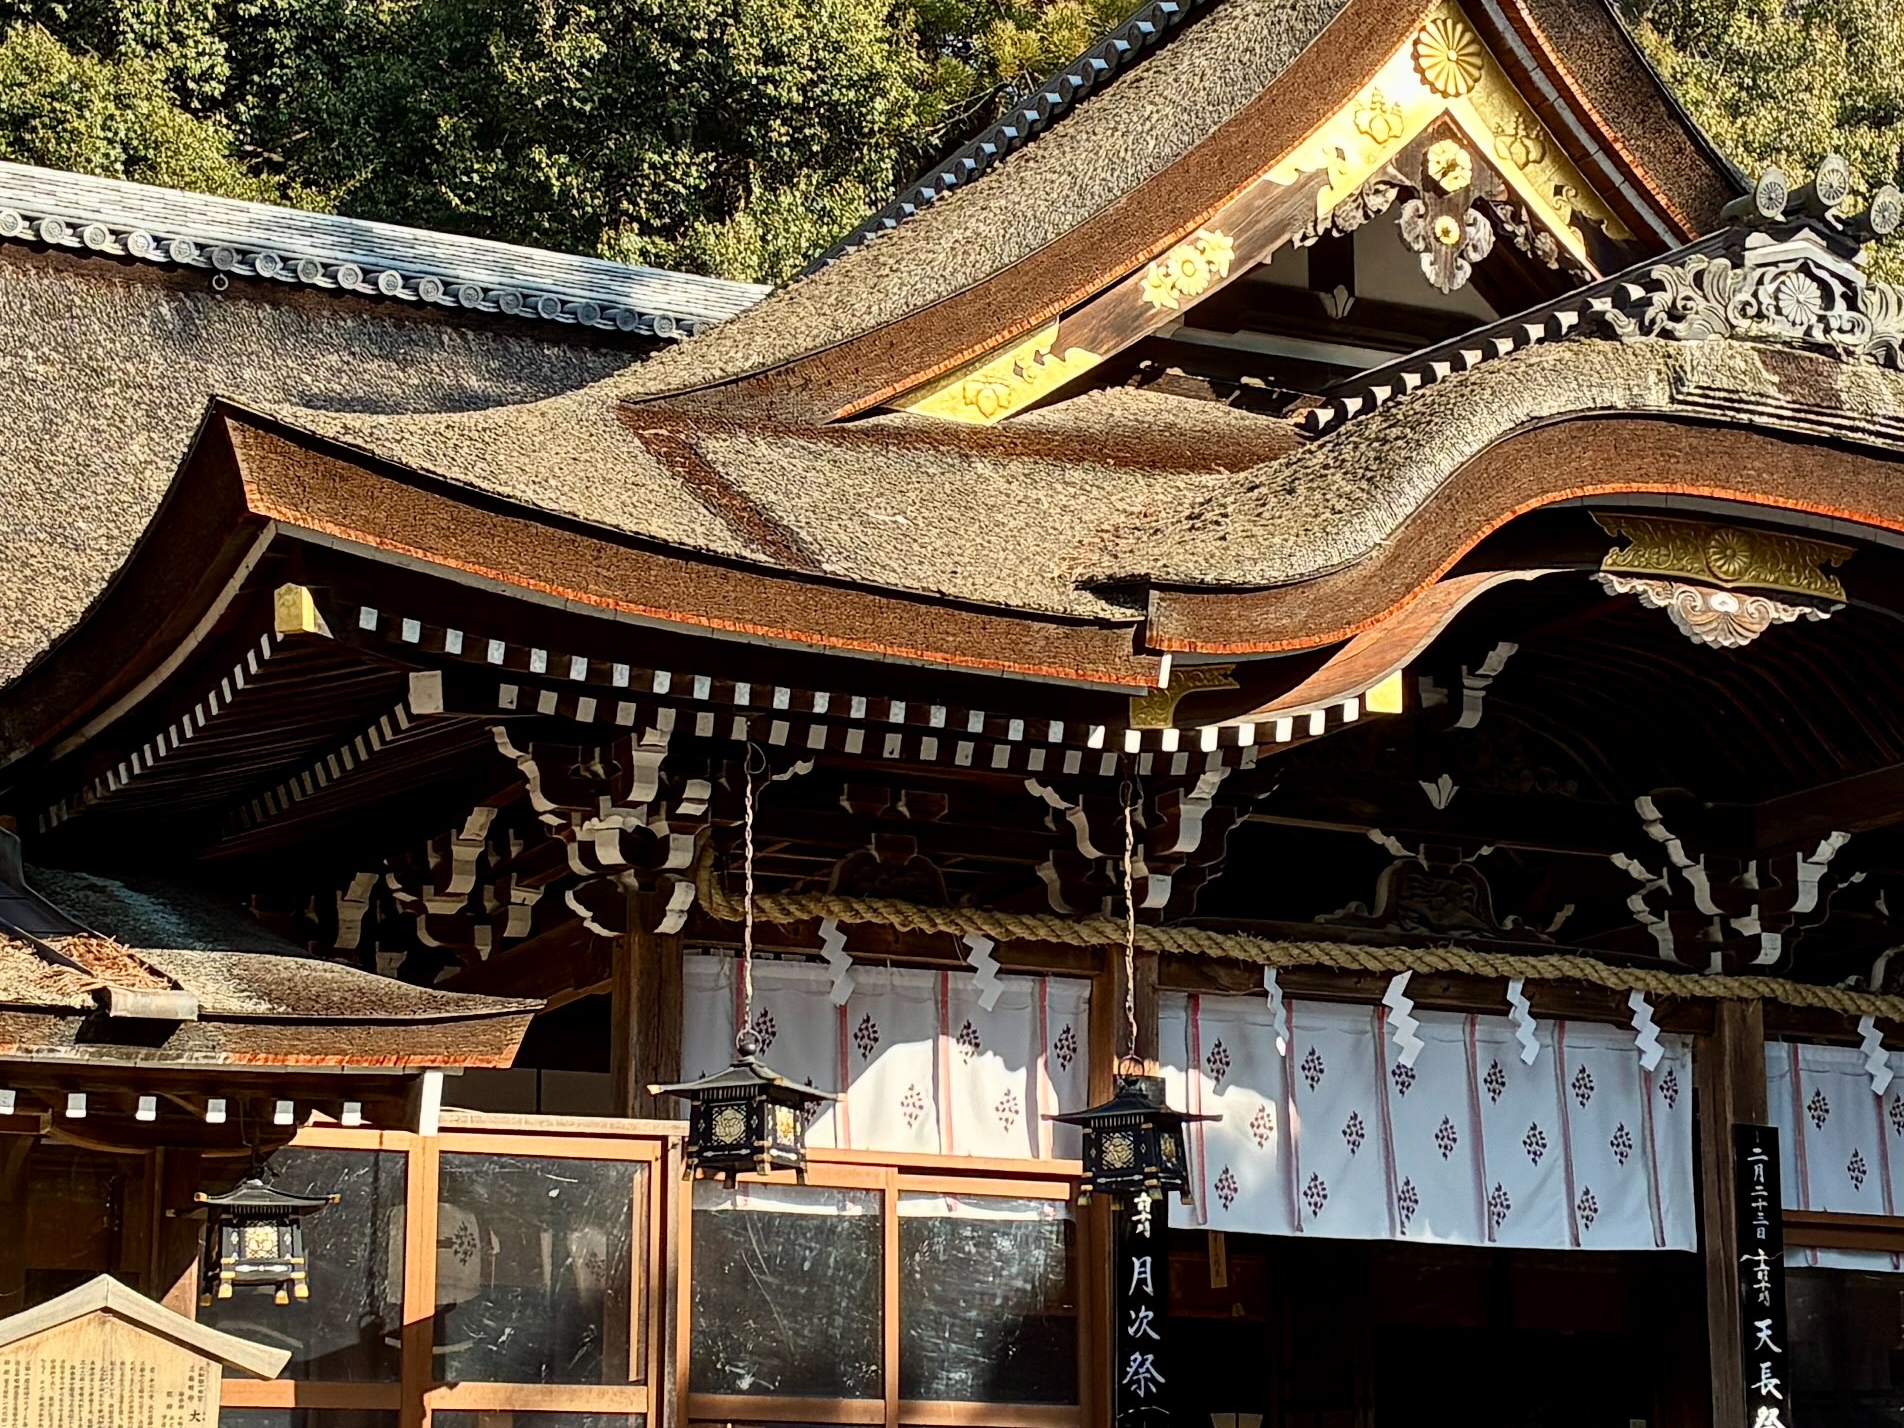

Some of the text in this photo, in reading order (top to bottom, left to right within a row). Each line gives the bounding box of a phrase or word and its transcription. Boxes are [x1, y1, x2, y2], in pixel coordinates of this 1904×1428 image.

[1747, 1147, 1769, 1240] 二月二十三日
[1121, 1256, 1166, 1398] 月次祭
